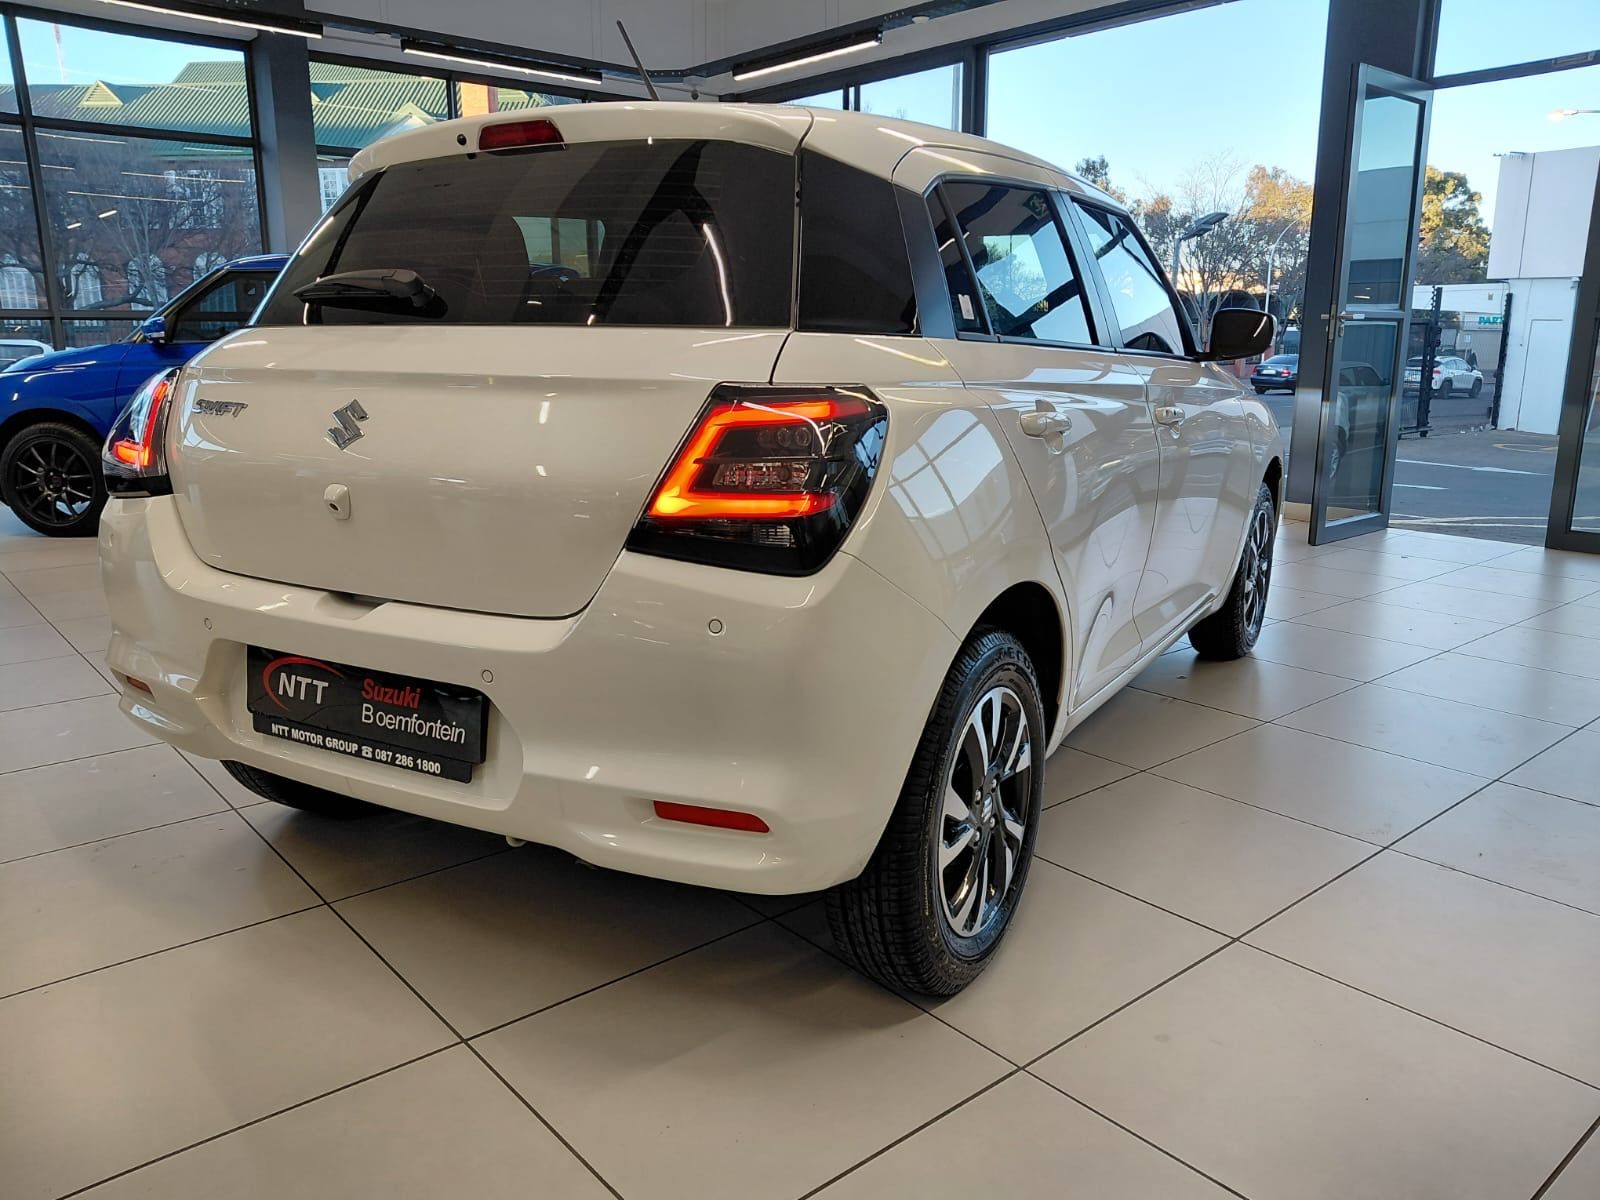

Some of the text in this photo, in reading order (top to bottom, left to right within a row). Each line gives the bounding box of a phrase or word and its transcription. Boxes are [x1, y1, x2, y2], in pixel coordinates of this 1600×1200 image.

[193, 399, 248, 417] SWIFT
[277, 672, 329, 704] NTT
[361, 678, 422, 709] Suzuki
[271, 723, 441, 774] NTT MOTOR GROUP 087 286 1800
